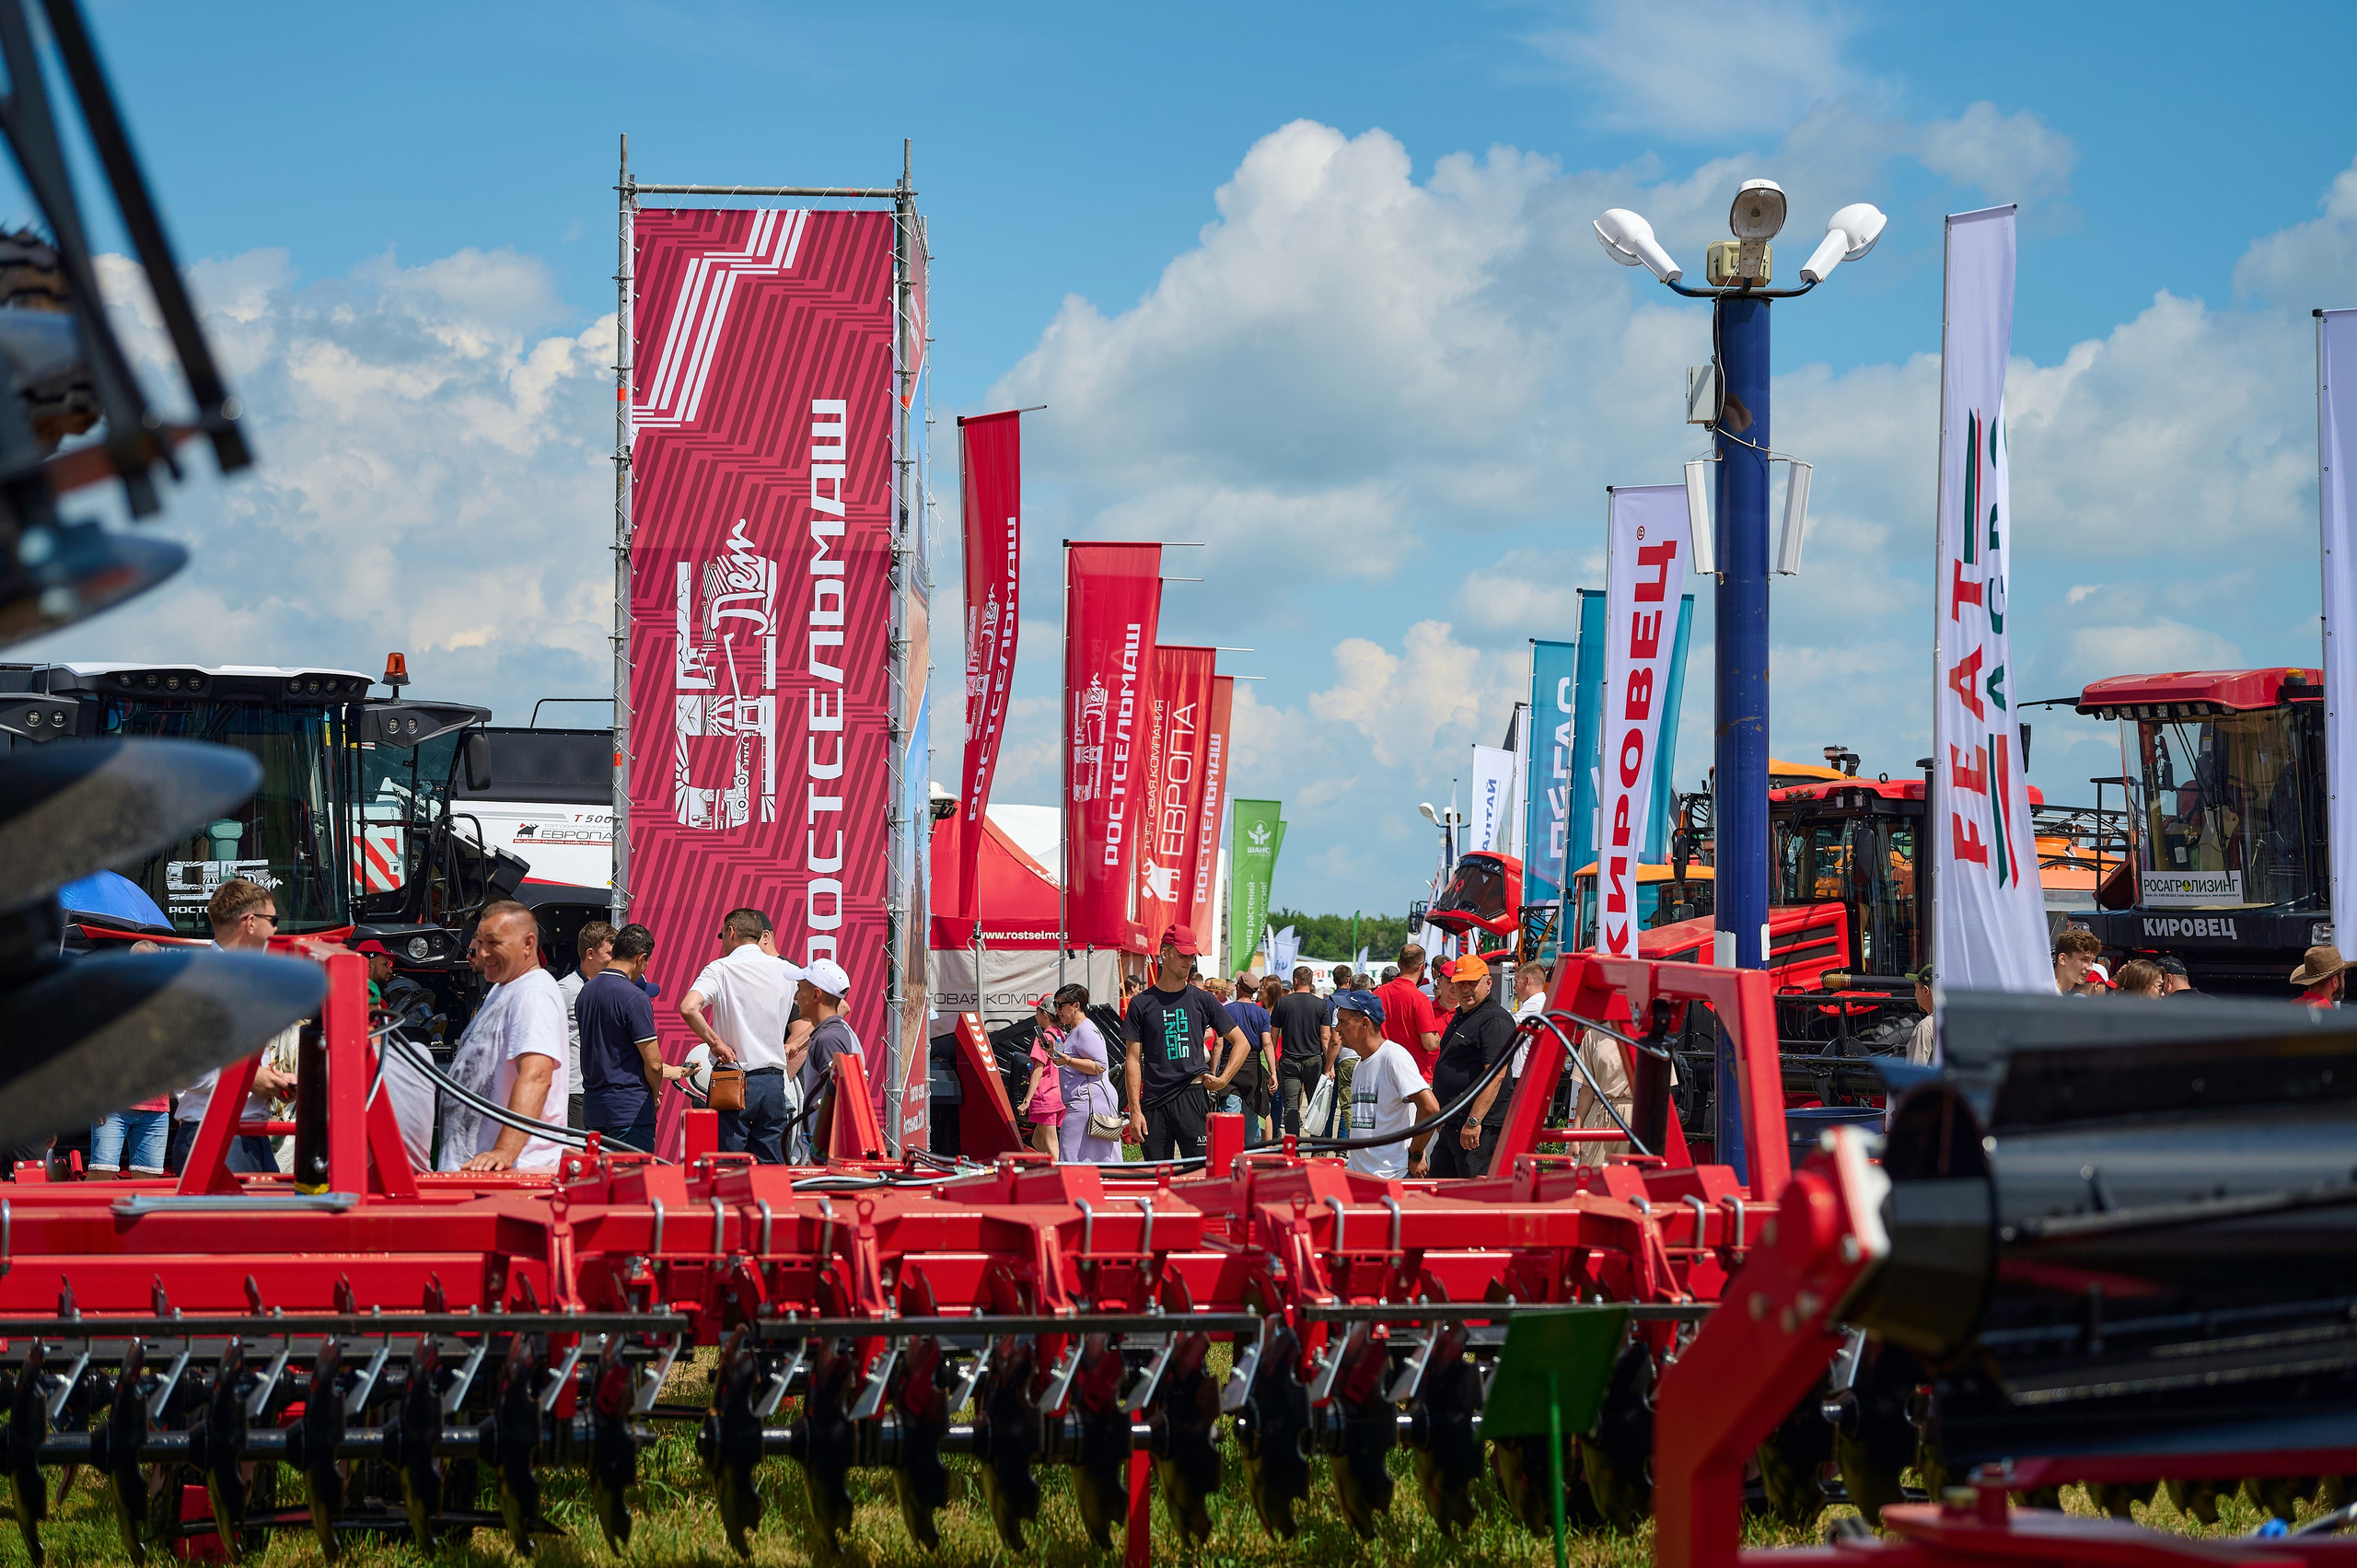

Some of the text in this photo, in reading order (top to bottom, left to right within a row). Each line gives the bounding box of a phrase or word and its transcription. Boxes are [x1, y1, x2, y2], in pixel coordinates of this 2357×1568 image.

[969, 517, 1016, 821] РОСТСЕЛЬМАШ
[1948, 558, 1990, 870] FEAT
[1105, 623, 1141, 865] РОСТСЕЛЬМАШ
[1144, 700, 1165, 851] ТОРГОВАЯ КОМПАНИЯ
[1161, 703, 1197, 856] ЕВРОПА
[541, 830, 613, 840] ЕВРОПА
[1196, 734, 1222, 903] РОСТСЕЛЬМАШ
[1247, 846, 1271, 854] ШАНС
[1247, 882, 1256, 926] растений
[2143, 878, 2238, 892] РОСАГРОЛИЗИНГ
[2143, 918, 2237, 939] КИРОВЕЦ
[1176, 1008, 1189, 1058] STOP
